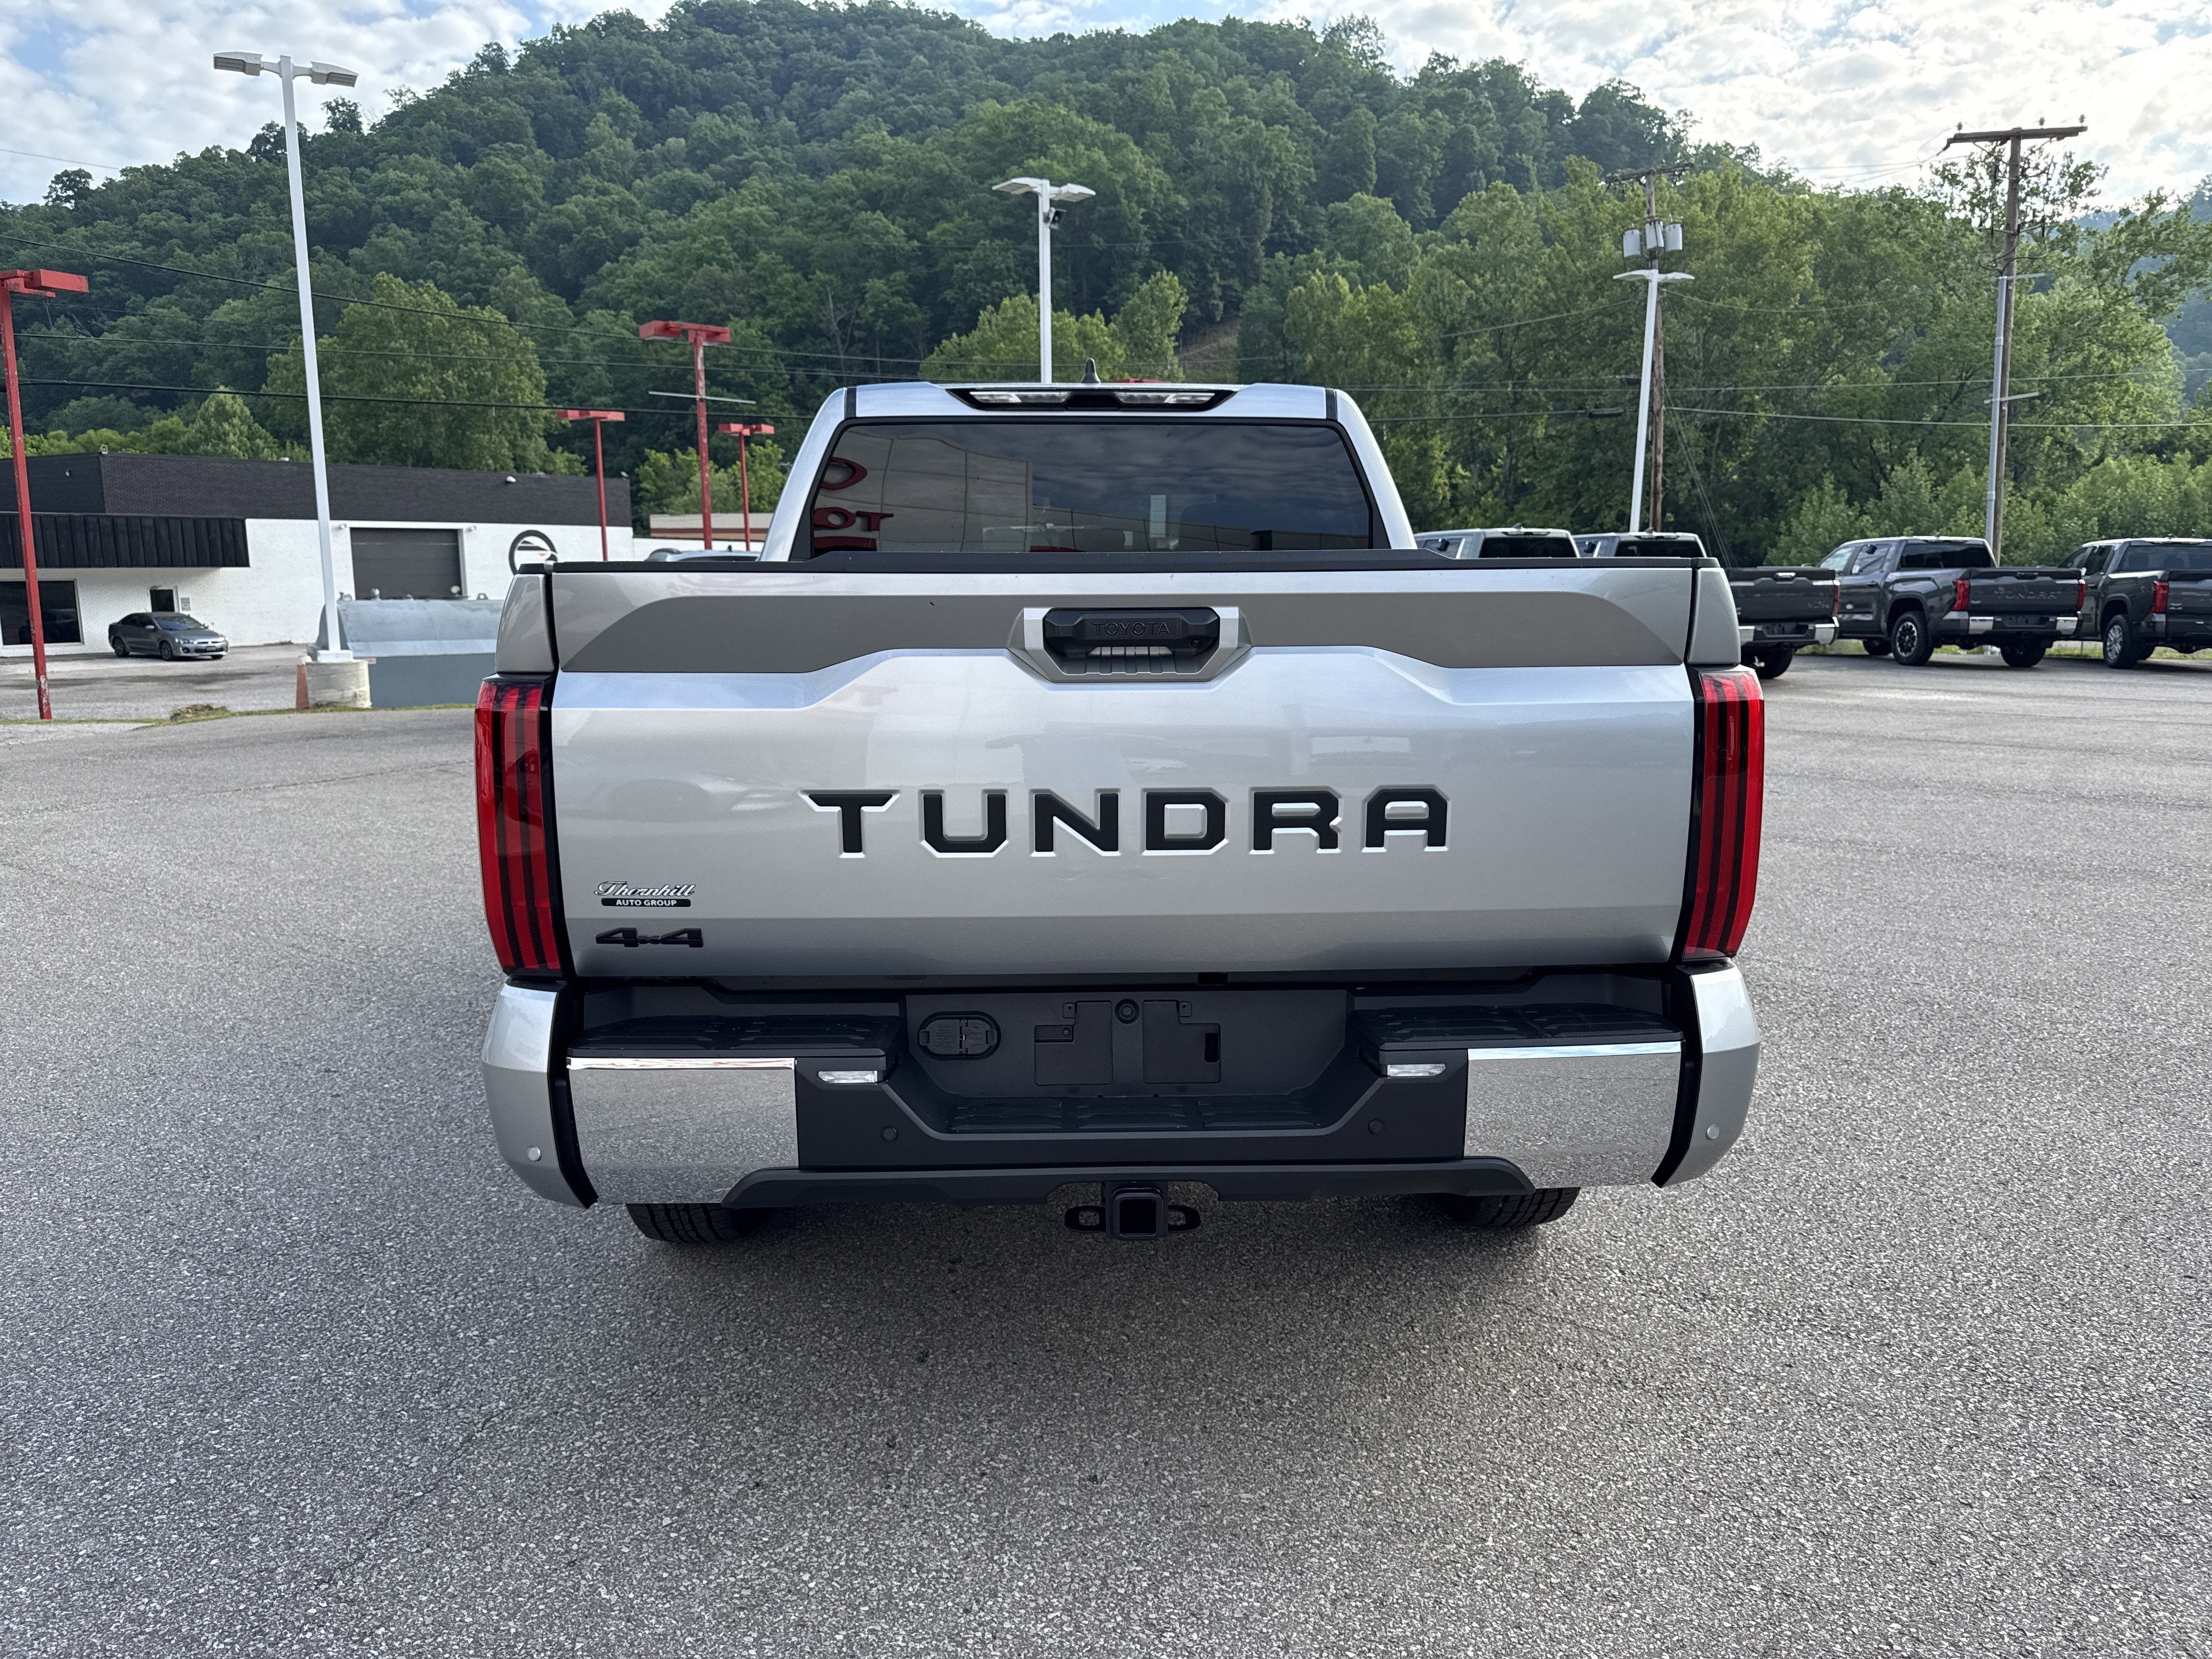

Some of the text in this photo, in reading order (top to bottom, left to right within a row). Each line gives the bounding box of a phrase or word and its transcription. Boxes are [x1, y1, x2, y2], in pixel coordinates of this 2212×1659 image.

[1092, 621, 1171, 636] TOYOTA
[802, 787, 1450, 857] TUNDRA
[594, 881, 696, 897] Thornhill
